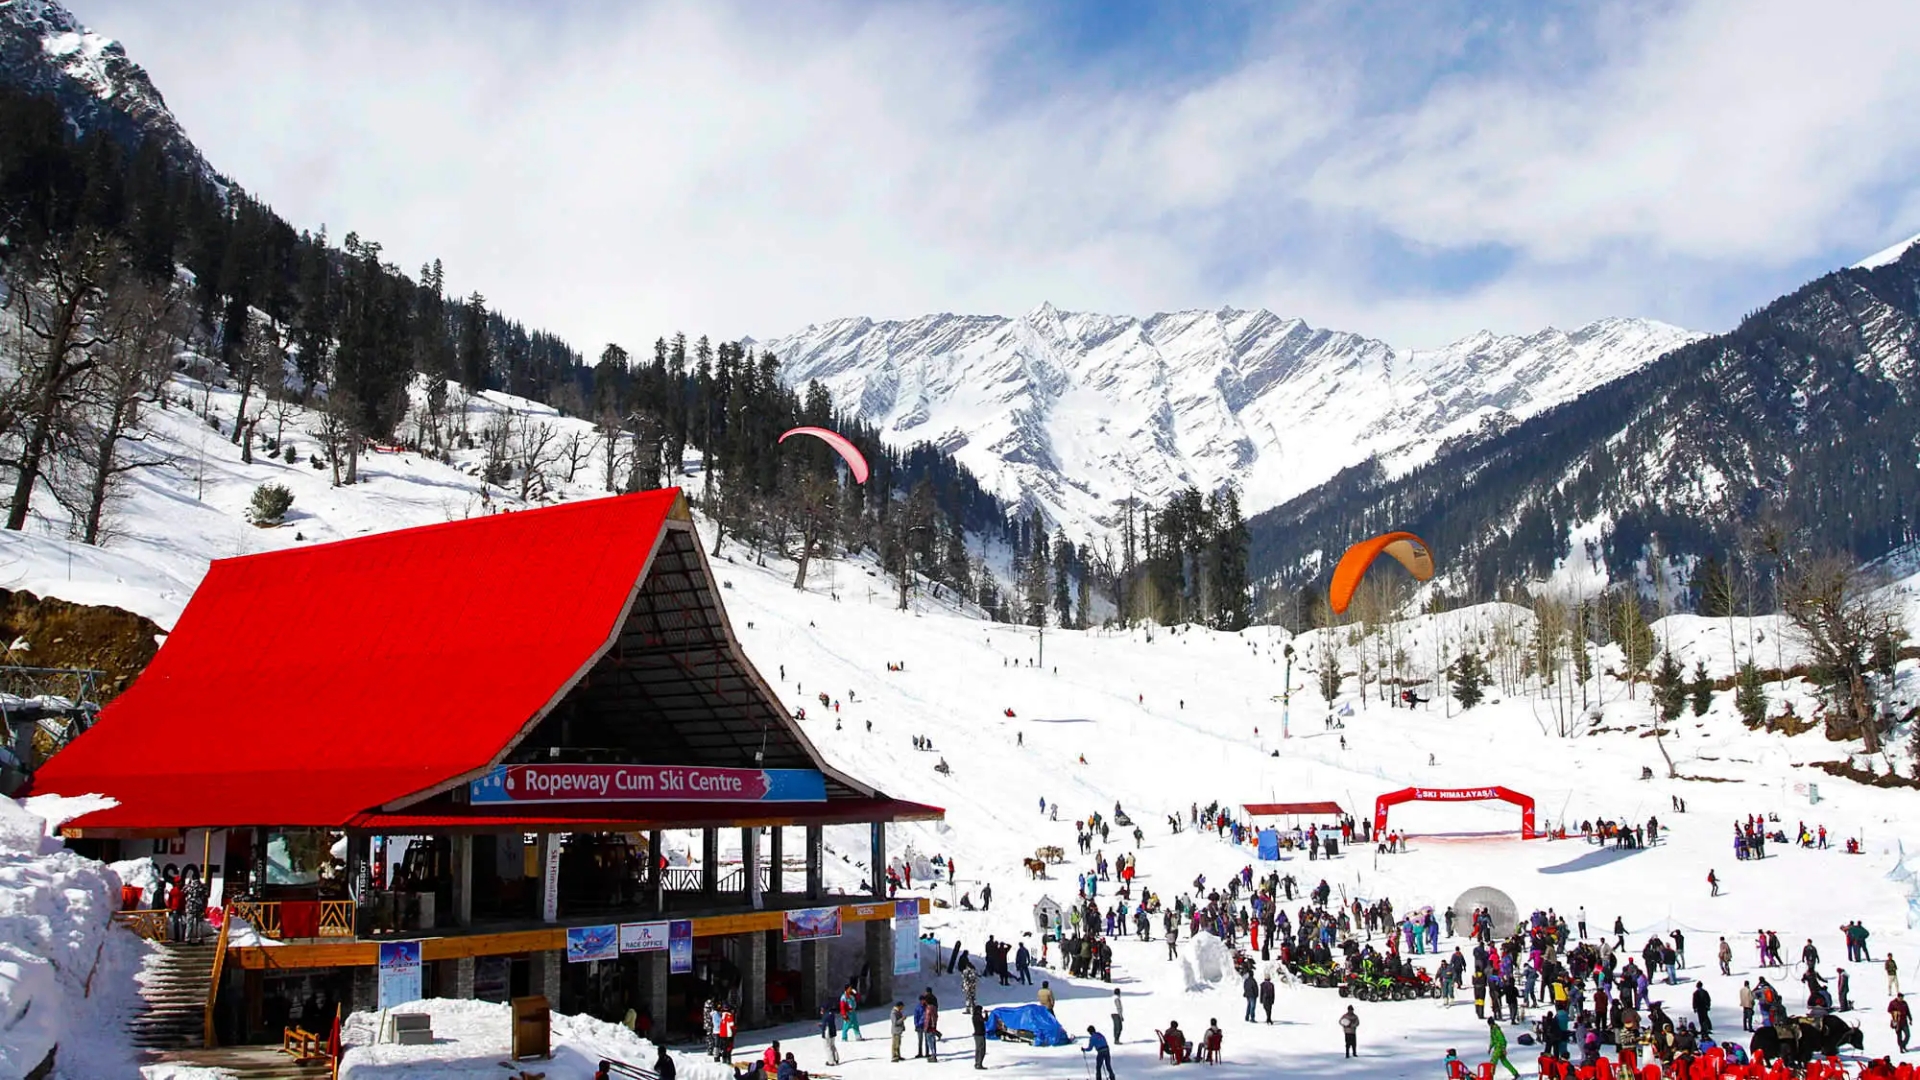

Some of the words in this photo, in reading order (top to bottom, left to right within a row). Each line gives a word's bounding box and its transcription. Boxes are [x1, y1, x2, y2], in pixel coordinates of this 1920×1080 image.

[525, 770, 610, 796] Ropeway
[615, 770, 655, 791] Cum
[660, 771, 684, 791] Ski
[688, 772, 742, 792] Centre
[1422, 790, 1437, 798] SKI
[1440, 789, 1488, 798] HIMALAYAS
[550, 849, 558, 863] Ski
[643, 940, 663, 948] OFFICE
